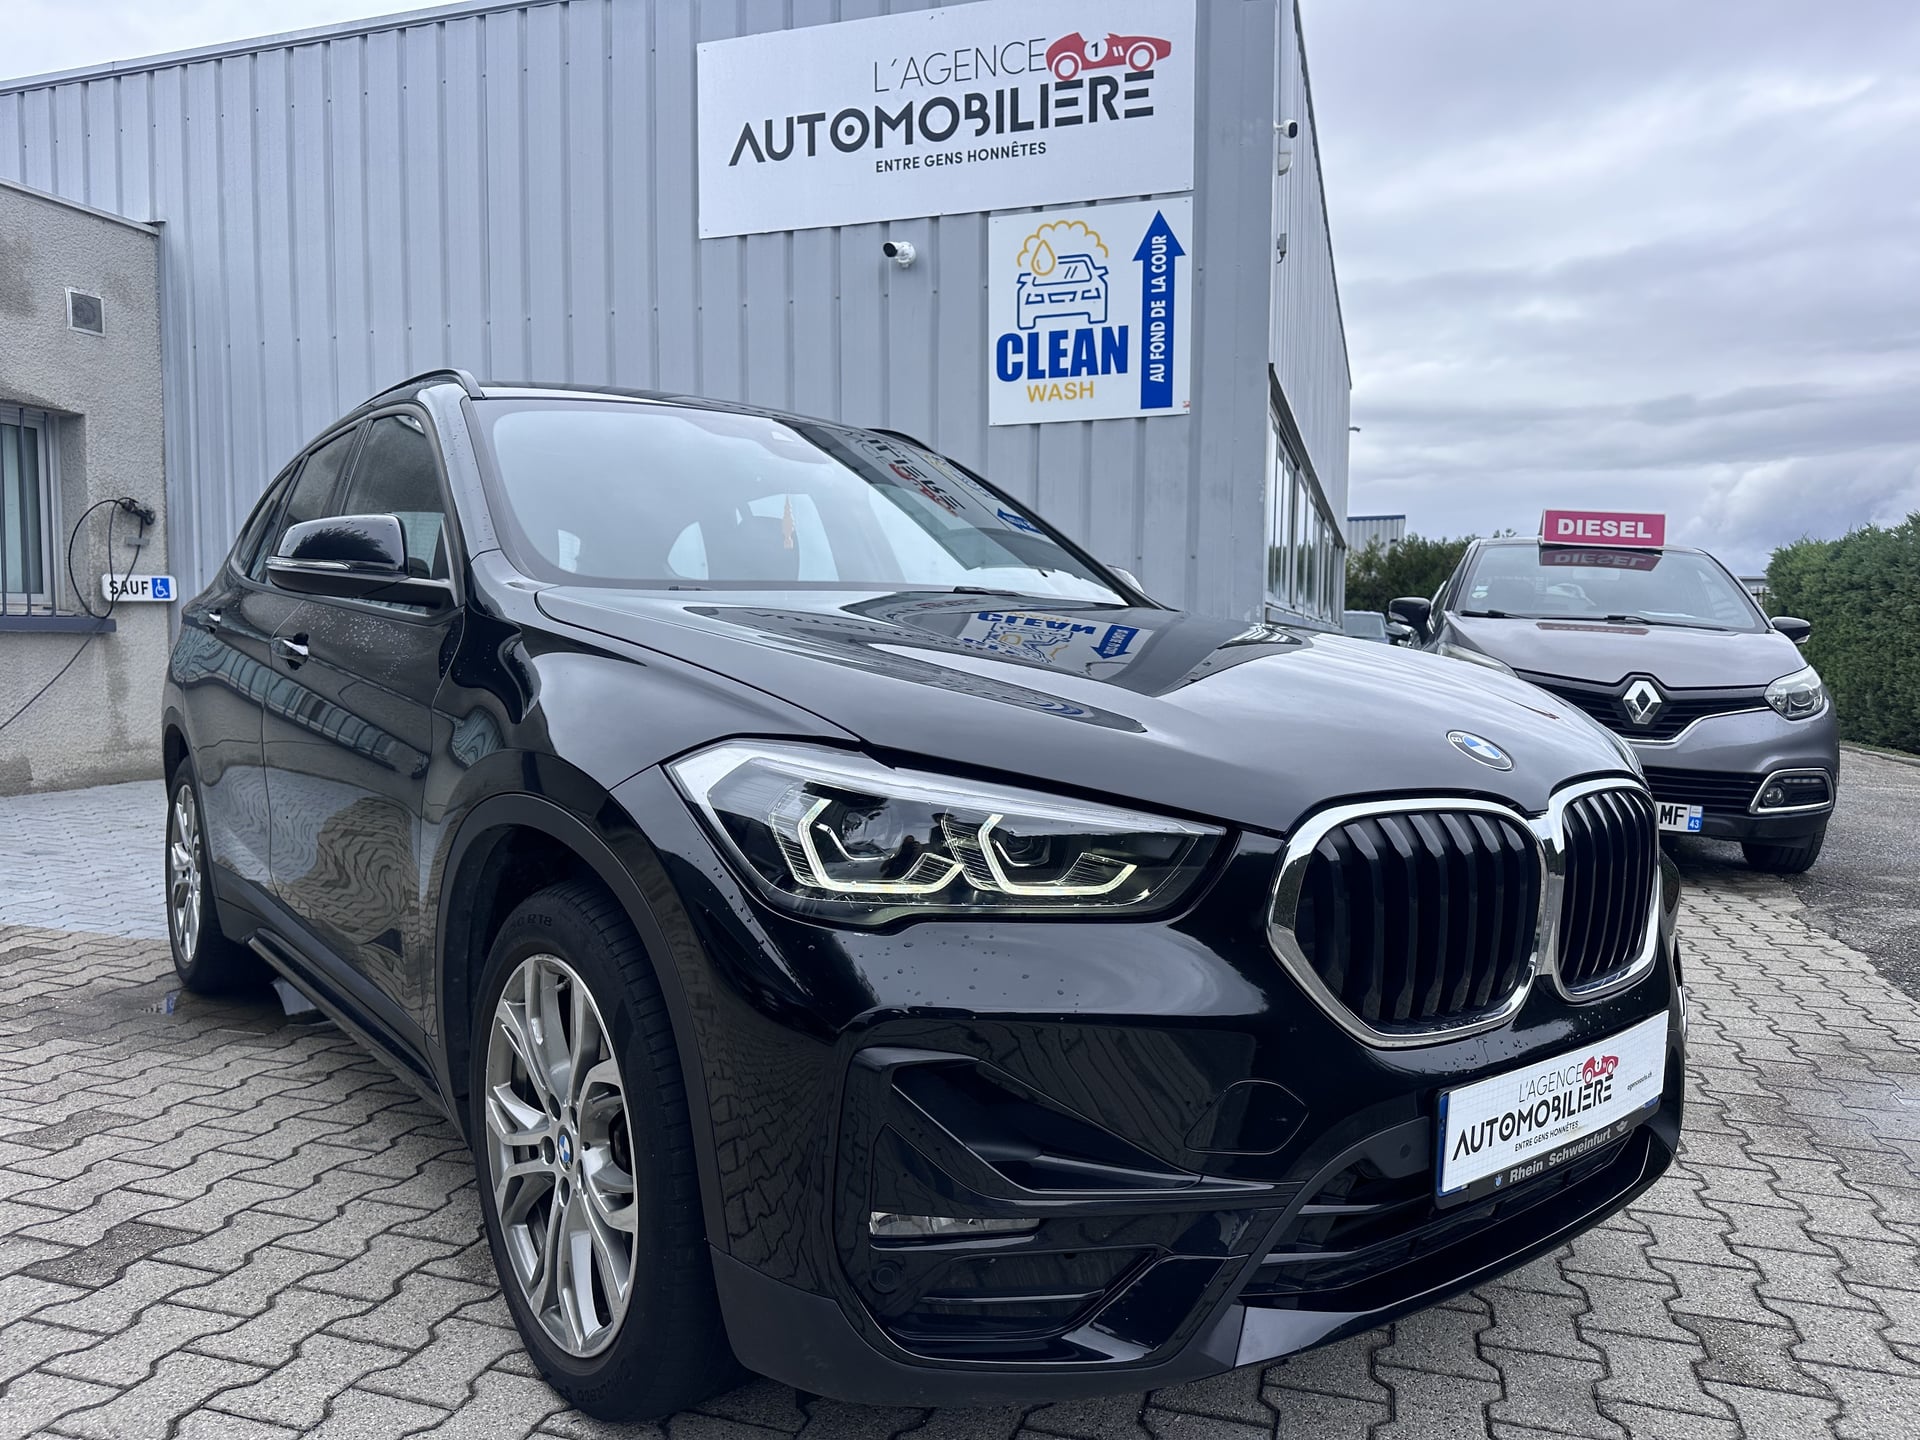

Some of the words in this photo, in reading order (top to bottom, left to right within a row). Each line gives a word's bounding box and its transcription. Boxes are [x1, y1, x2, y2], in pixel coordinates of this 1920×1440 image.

[1090, 41, 1099, 58] 1
[874, 37, 1047, 93] L'AGENCE
[875, 156, 921, 173] ENTRE
[924, 151, 963, 168] GENS
[967, 140, 1047, 163] HONNÊTES
[1151, 234, 1168, 273] COUR
[1151, 275, 1167, 293] LA
[1150, 299, 1166, 318] DE
[996, 325, 1129, 382] CLEAN
[1149, 322, 1166, 361] FOND
[1149, 363, 1165, 383] AU
[1026, 380, 1095, 403] WASH
[1557, 518, 1652, 538] DIESEL
[109, 580, 149, 595] SAUF
[1689, 818, 1700, 829] 43
[1518, 1062, 1583, 1103] L'AGENCE
[1514, 1138, 1533, 1152] ENTRE
[1533, 1131, 1549, 1145] GENS
[1549, 1120, 1580, 1139] HONNÊTES
[1509, 1160, 1544, 1183] Rhein
[1548, 1127, 1612, 1167] Schweinfurt
